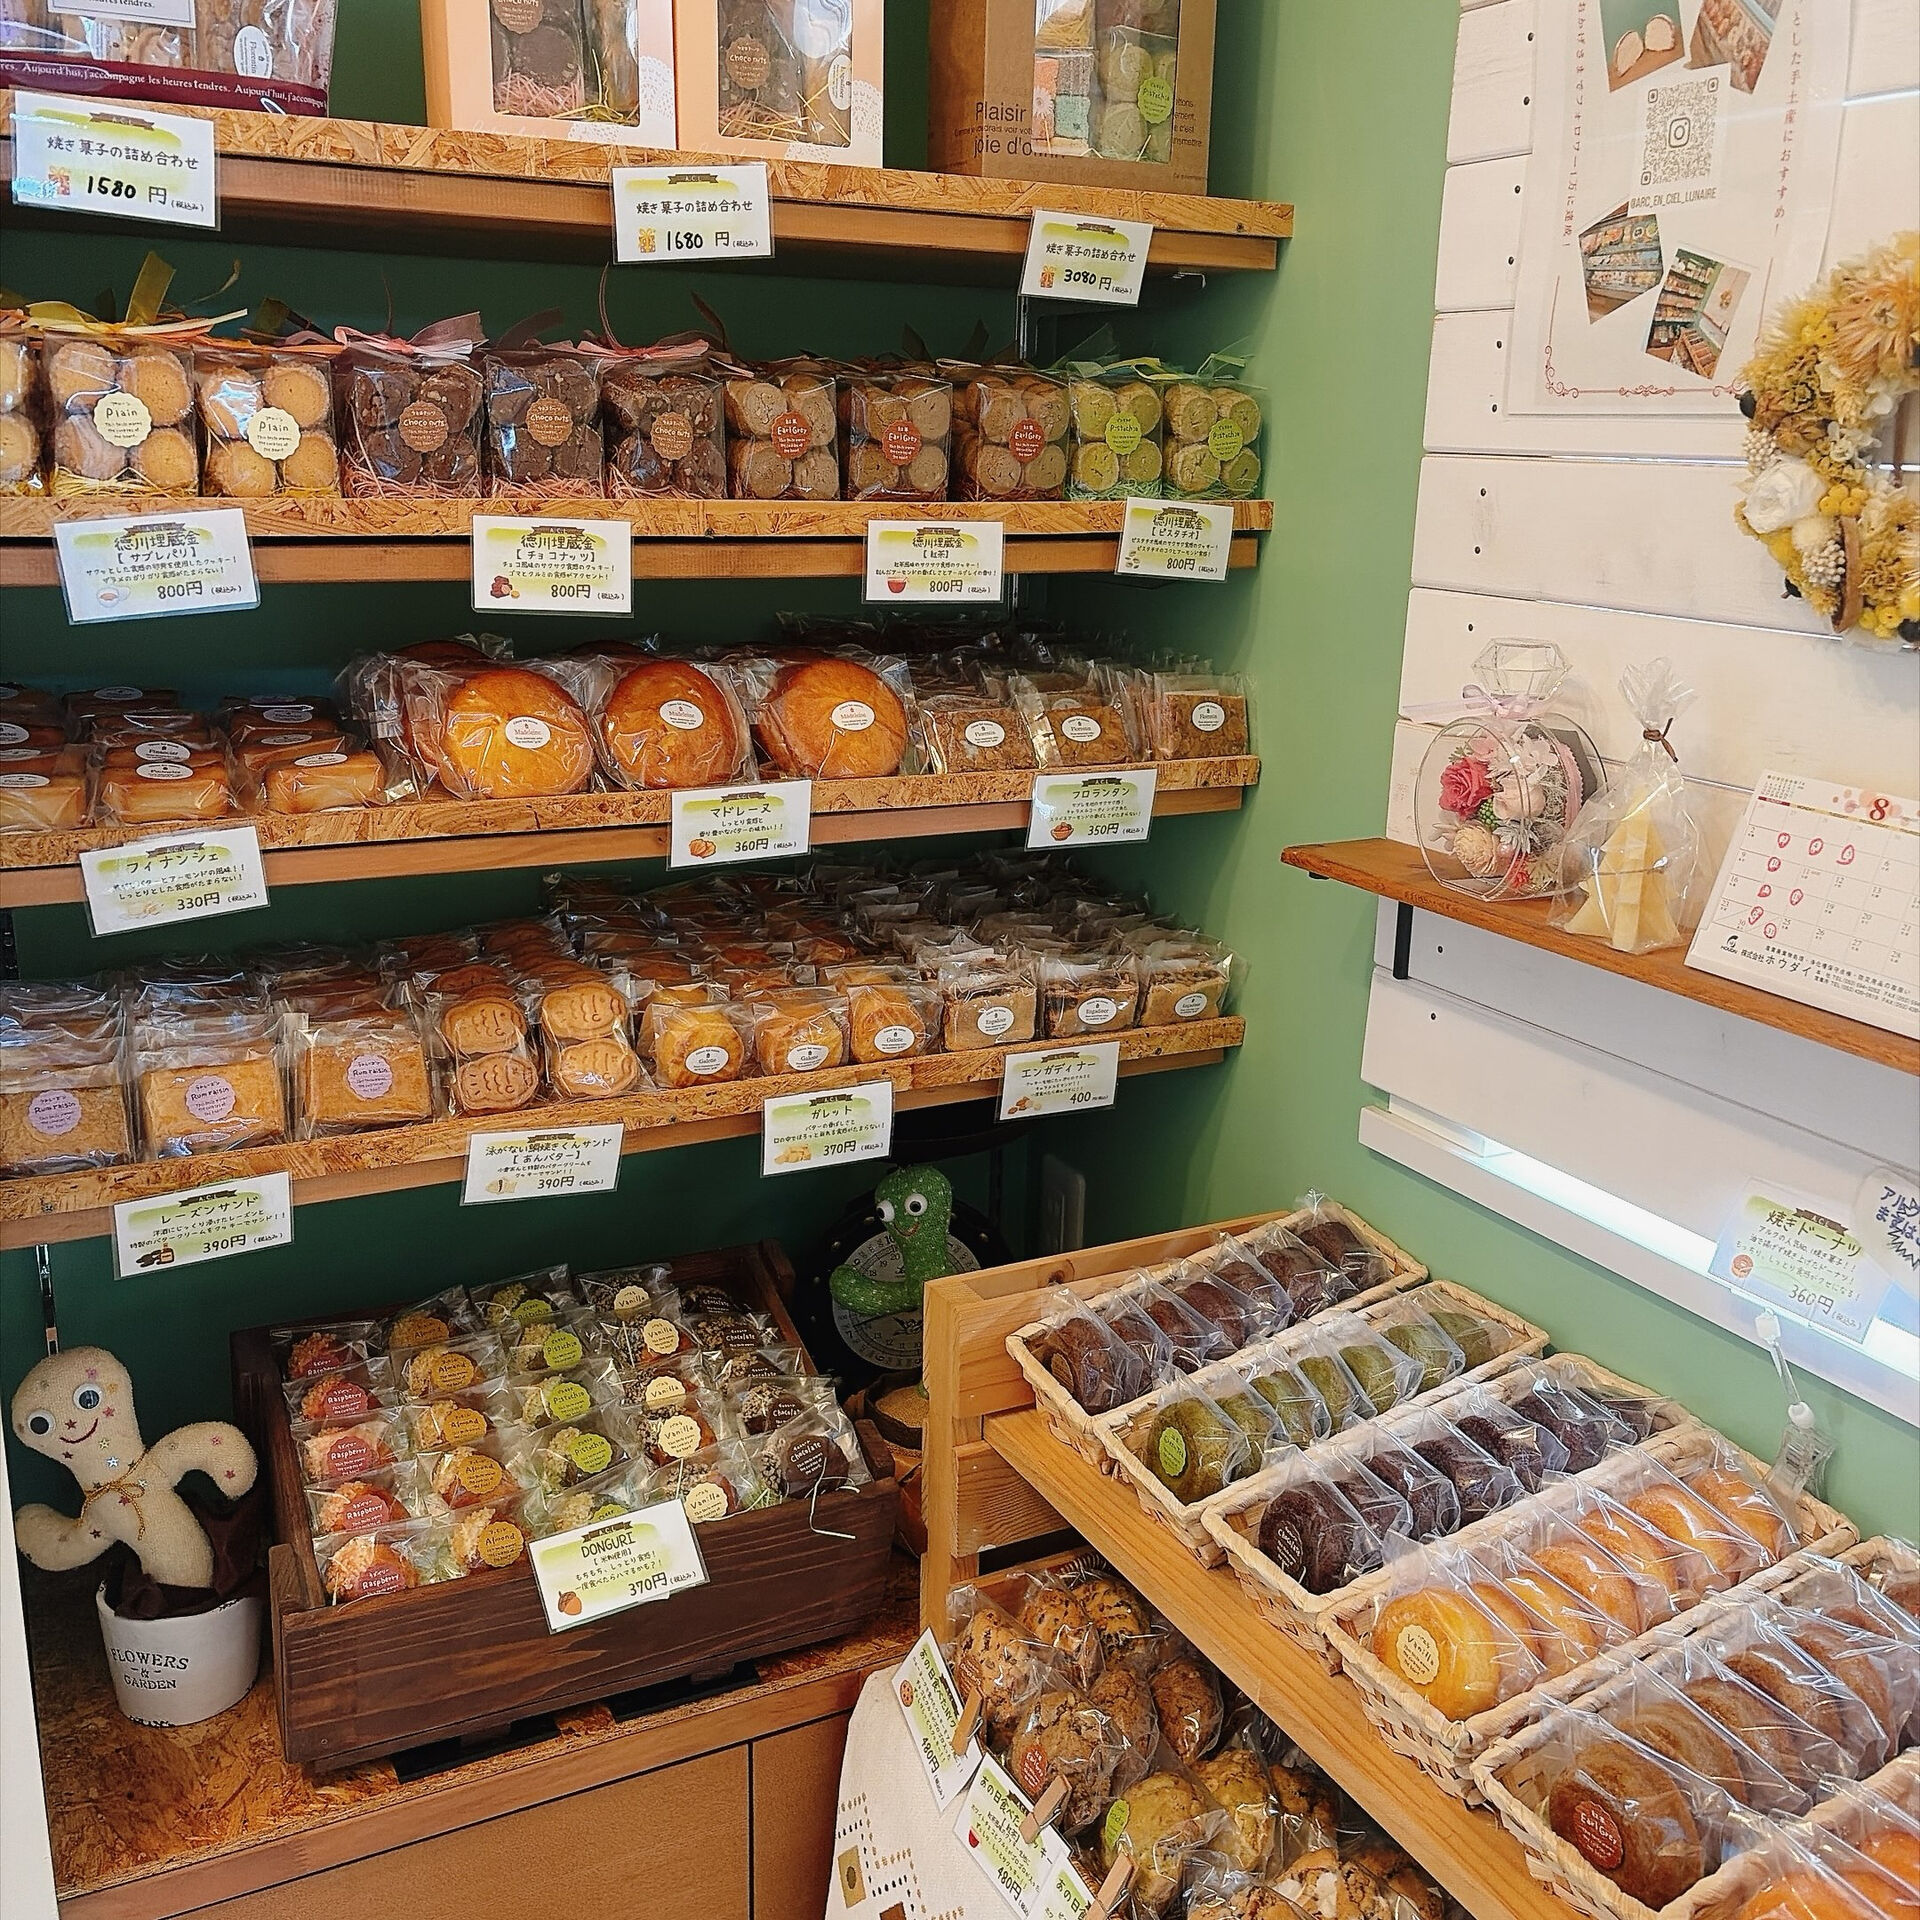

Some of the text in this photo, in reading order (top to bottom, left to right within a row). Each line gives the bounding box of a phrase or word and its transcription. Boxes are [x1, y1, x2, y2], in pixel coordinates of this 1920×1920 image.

[148, 75, 231, 92] les heures tendres.
[975, 102, 1027, 123] Plaisir
[46, 135, 200, 171] 焼き菓子の詰め合わせ
[973, 137, 1002, 159] joie
[87, 175, 137, 200] 1580
[148, 185, 168, 206] 円
[636, 199, 754, 215] 焼き菓子の詰め合わせ
[667, 230, 704, 251] 1680
[715, 231, 730, 247] 円
[1045, 242, 1137, 262] 焼き菓子の詰め合わせ
[1063, 268, 1097, 285] 3080
[1098, 276, 1113, 291] 円
[106, 407, 138, 418] Plain
[530, 414, 569, 423] Choco nuts
[258, 420, 289, 433] Plain
[403, 419, 428, 427] Choco
[654, 428, 690, 438] Choco nuts
[1152, 514, 1205, 531] 徳川埋蔵金
[114, 529, 200, 552] 徳川埋蔵金
[1152, 526, 1199, 540] 【ピスタチオ】
[520, 535, 597, 552] 徳川埋蔵金
[912, 537, 965, 549] 徳川埋蔵金
[516, 548, 596, 563] 【チョコナッツ】
[923, 549, 949, 559] 【紅茶】
[1166, 558, 1196, 571] 800円
[158, 580, 203, 600] 800円
[550, 583, 591, 599] 800円
[929, 579, 963, 593] 800円
[1072, 787, 1130, 799] フロランタン
[710, 803, 772, 818] マドレーヌ
[1869, 798, 1890, 821] 8
[1087, 822, 1120, 837] 350円
[734, 837, 769, 853] 360円
[127, 852, 220, 874] フィナンシェ
[177, 891, 220, 911] 330円
[352, 1069, 368, 1077] Rum
[1021, 1061, 1096, 1078] エンガディナー
[190, 1087, 230, 1101] Rum raisin
[1069, 1091, 1091, 1104] 400
[34, 1102, 77, 1114] Rum raisin
[811, 1105, 852, 1120] ガレット
[485, 1138, 613, 1157] 泳がない鯛焼きくんサンド
[823, 1140, 857, 1156] 370円
[513, 1151, 581, 1165] 【あんバター】
[537, 1176, 575, 1190] 390円
[161, 1196, 258, 1224] レーズンサンド
[1765, 1210, 1862, 1258] 焼きドーナツ
[202, 1234, 247, 1254] 390円
[618, 1295, 646, 1307] Vanilla
[1787, 1284, 1835, 1315] 360円
[647, 1328, 673, 1338] Vanilla
[326, 1392, 362, 1404] Raspberry
[650, 1386, 679, 1398] Vanilla
[450, 1418, 479, 1428] Almond
[664, 1425, 694, 1440] Vanilla
[330, 1447, 367, 1461] Raspberry
[790, 1441, 823, 1462] Chocolate
[465, 1463, 494, 1473] Almond
[690, 1493, 720, 1510] Vanilla
[346, 1504, 383, 1519] Raspberry
[484, 1534, 516, 1546] Almond
[581, 1531, 637, 1559] DONGURI
[592, 1549, 633, 1567] 【米粉使用】
[362, 1573, 400, 1590] Raspberry
[628, 1571, 668, 1597] 370円
[1407, 1633, 1435, 1666] Vanilla
[110, 1647, 189, 1670] FLOWERS
[124, 1674, 177, 1690] GARDEN
[921, 1736, 940, 1774] 480円
[1580, 1812, 1600, 1831] Earl
[997, 1867, 1022, 1901] 480円
